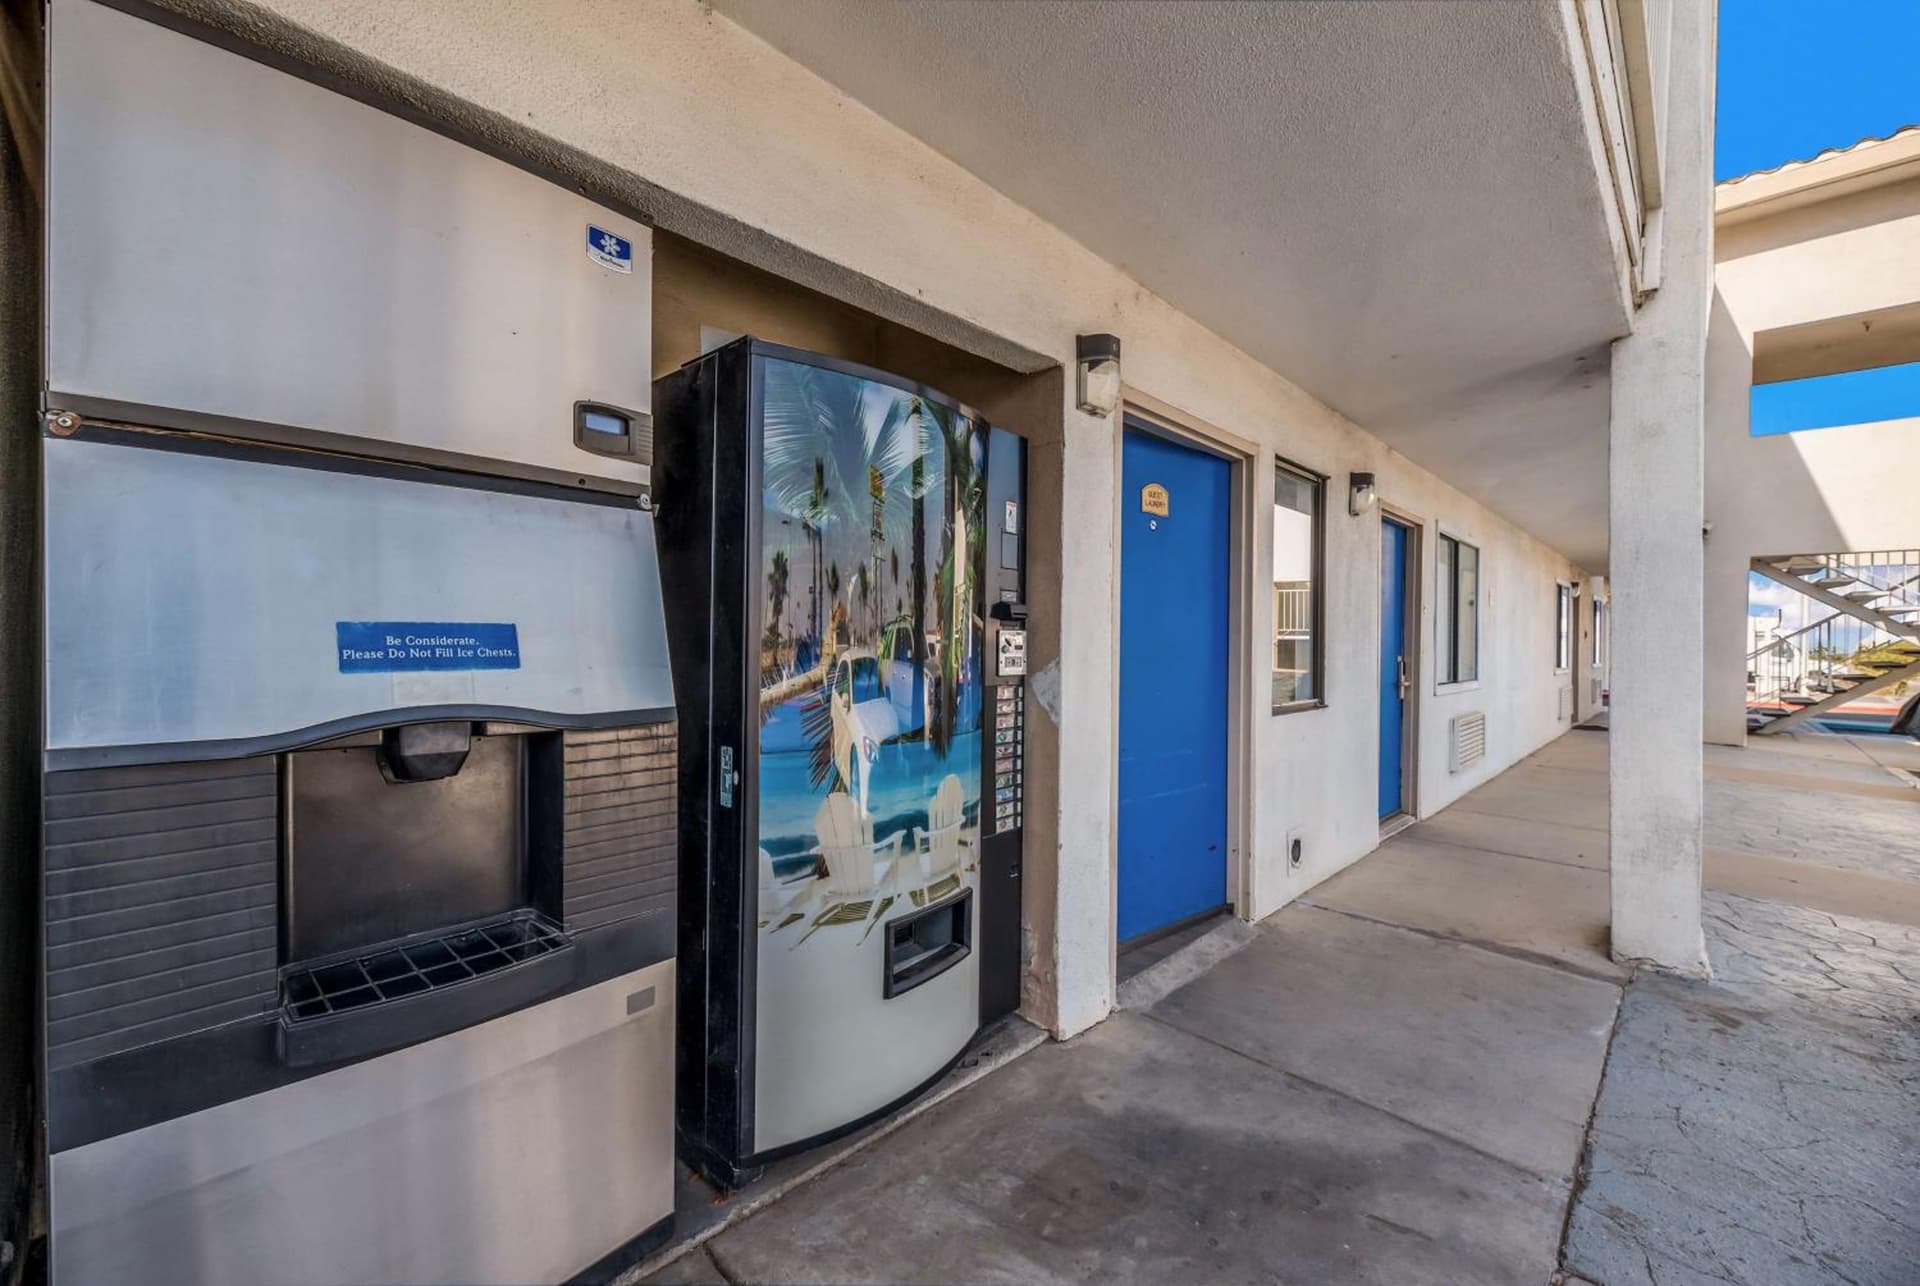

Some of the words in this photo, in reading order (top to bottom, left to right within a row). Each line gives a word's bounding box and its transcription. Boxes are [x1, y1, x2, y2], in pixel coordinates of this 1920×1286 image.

[386, 635, 402, 646] Be
[405, 635, 480, 646] Considerate.
[343, 648, 384, 660] Please
[388, 648, 406, 659] Do
[410, 648, 432, 658] Not
[435, 647, 454, 658] Fill
[457, 647, 474, 658] Ice
[477, 647, 516, 658] Chests.
